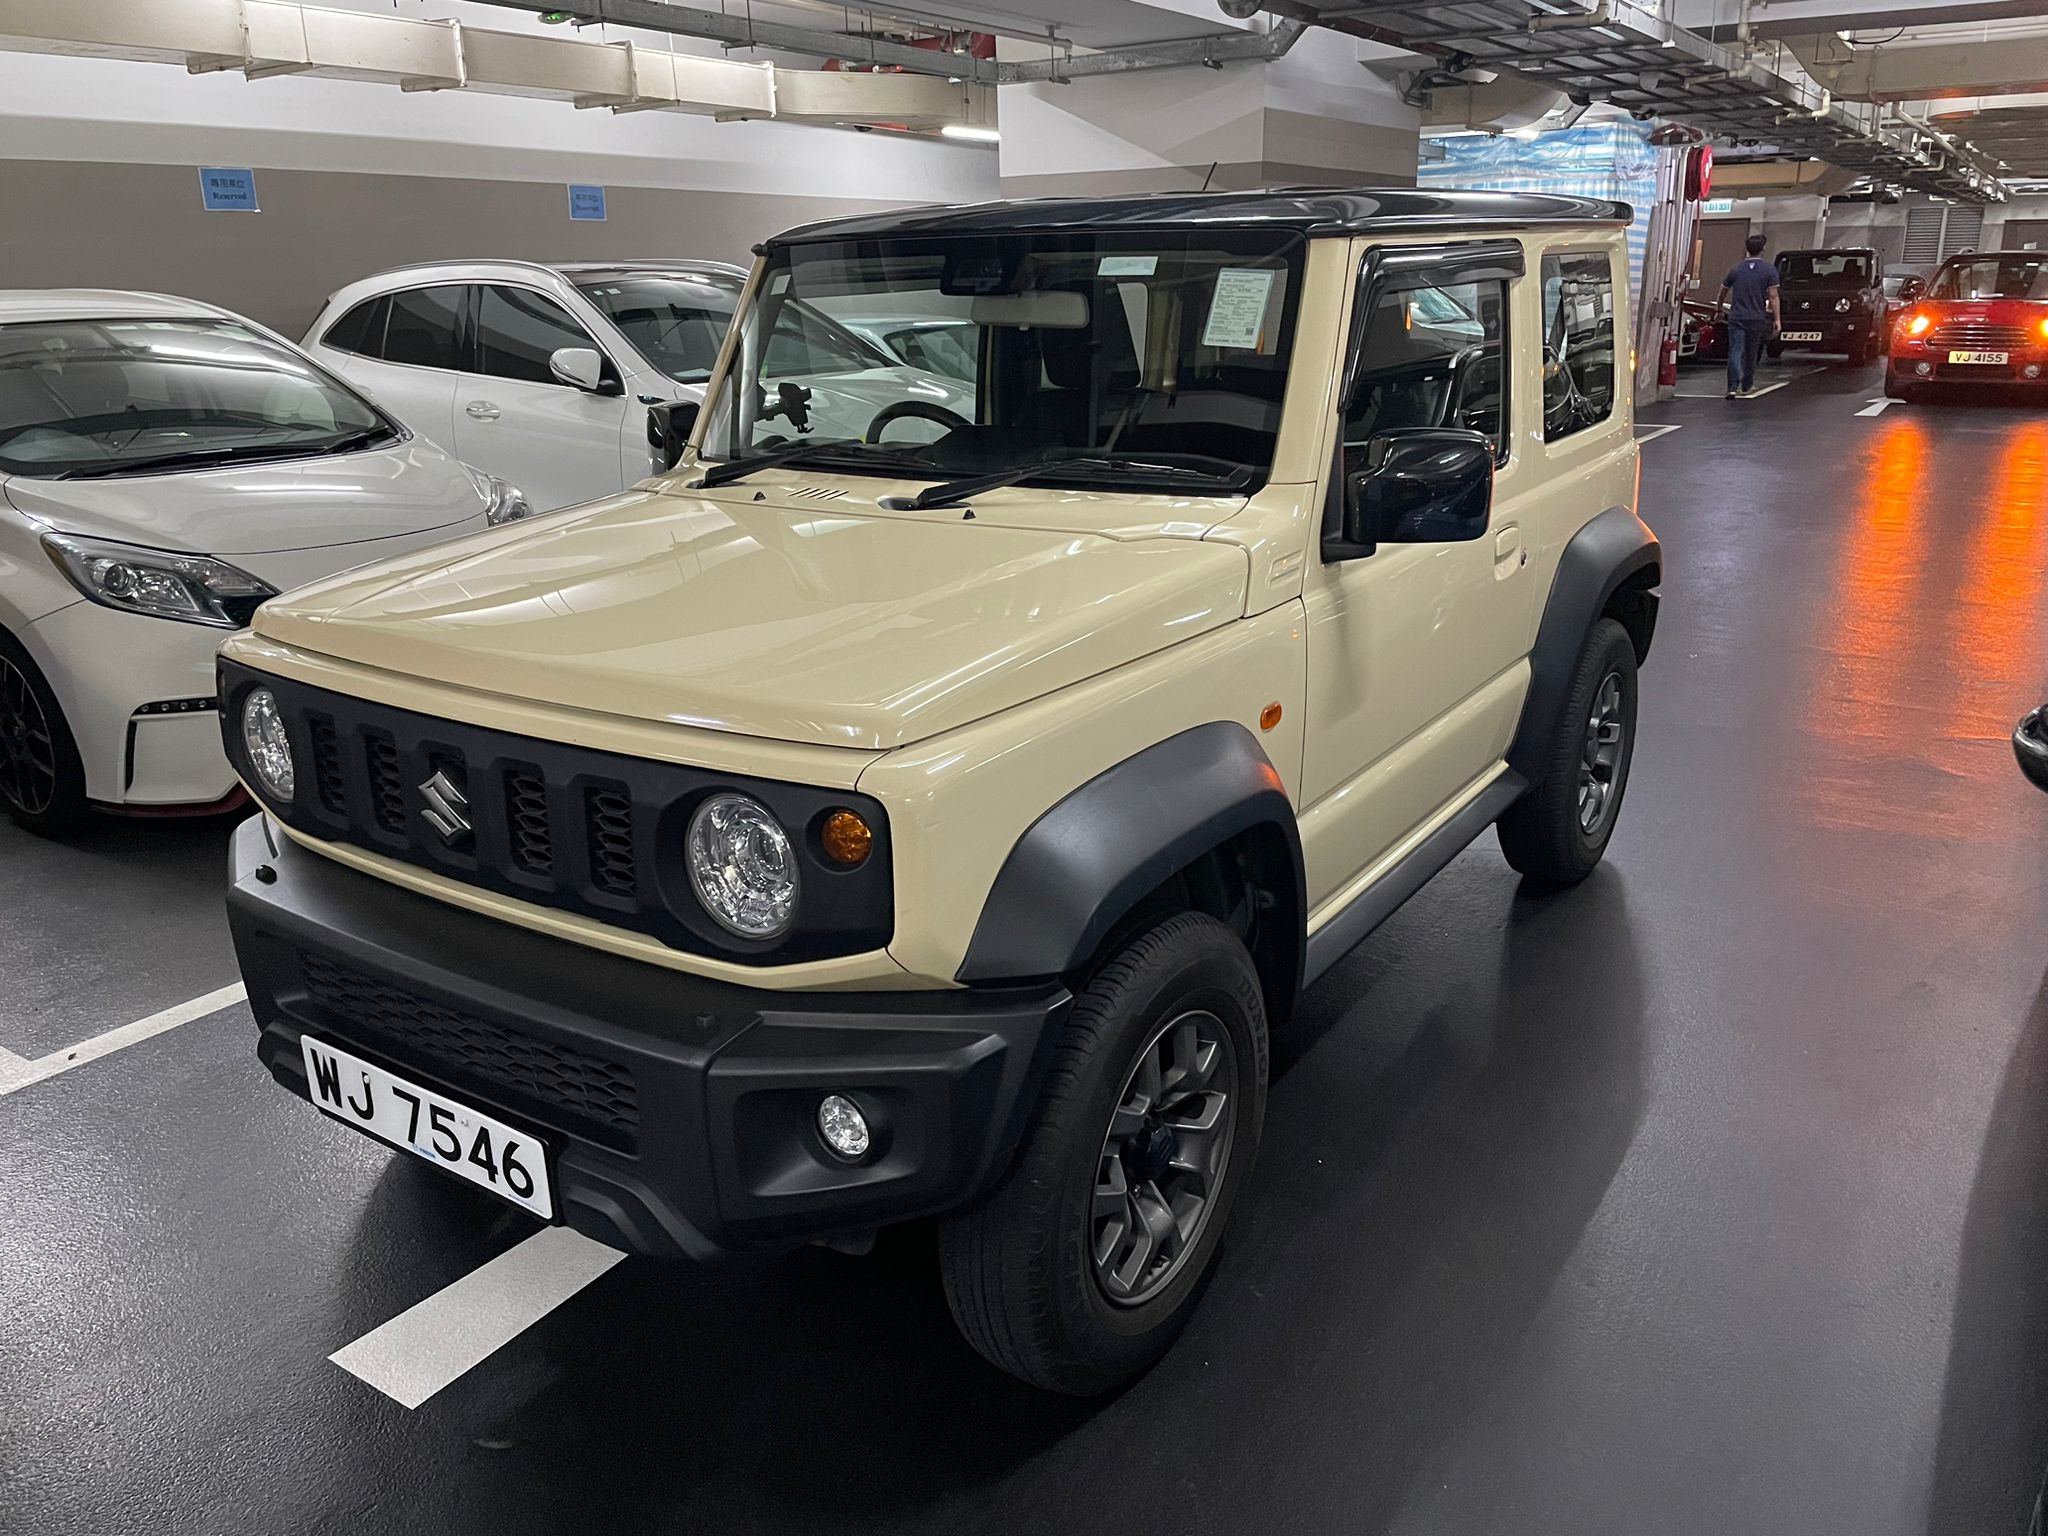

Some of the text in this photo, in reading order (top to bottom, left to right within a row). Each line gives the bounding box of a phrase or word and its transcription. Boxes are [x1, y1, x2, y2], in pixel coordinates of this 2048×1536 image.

[212, 191, 247, 200] Reserved
[1956, 353, 2003, 363] VJ 4155
[309, 1046, 535, 1199] WJ 7546
